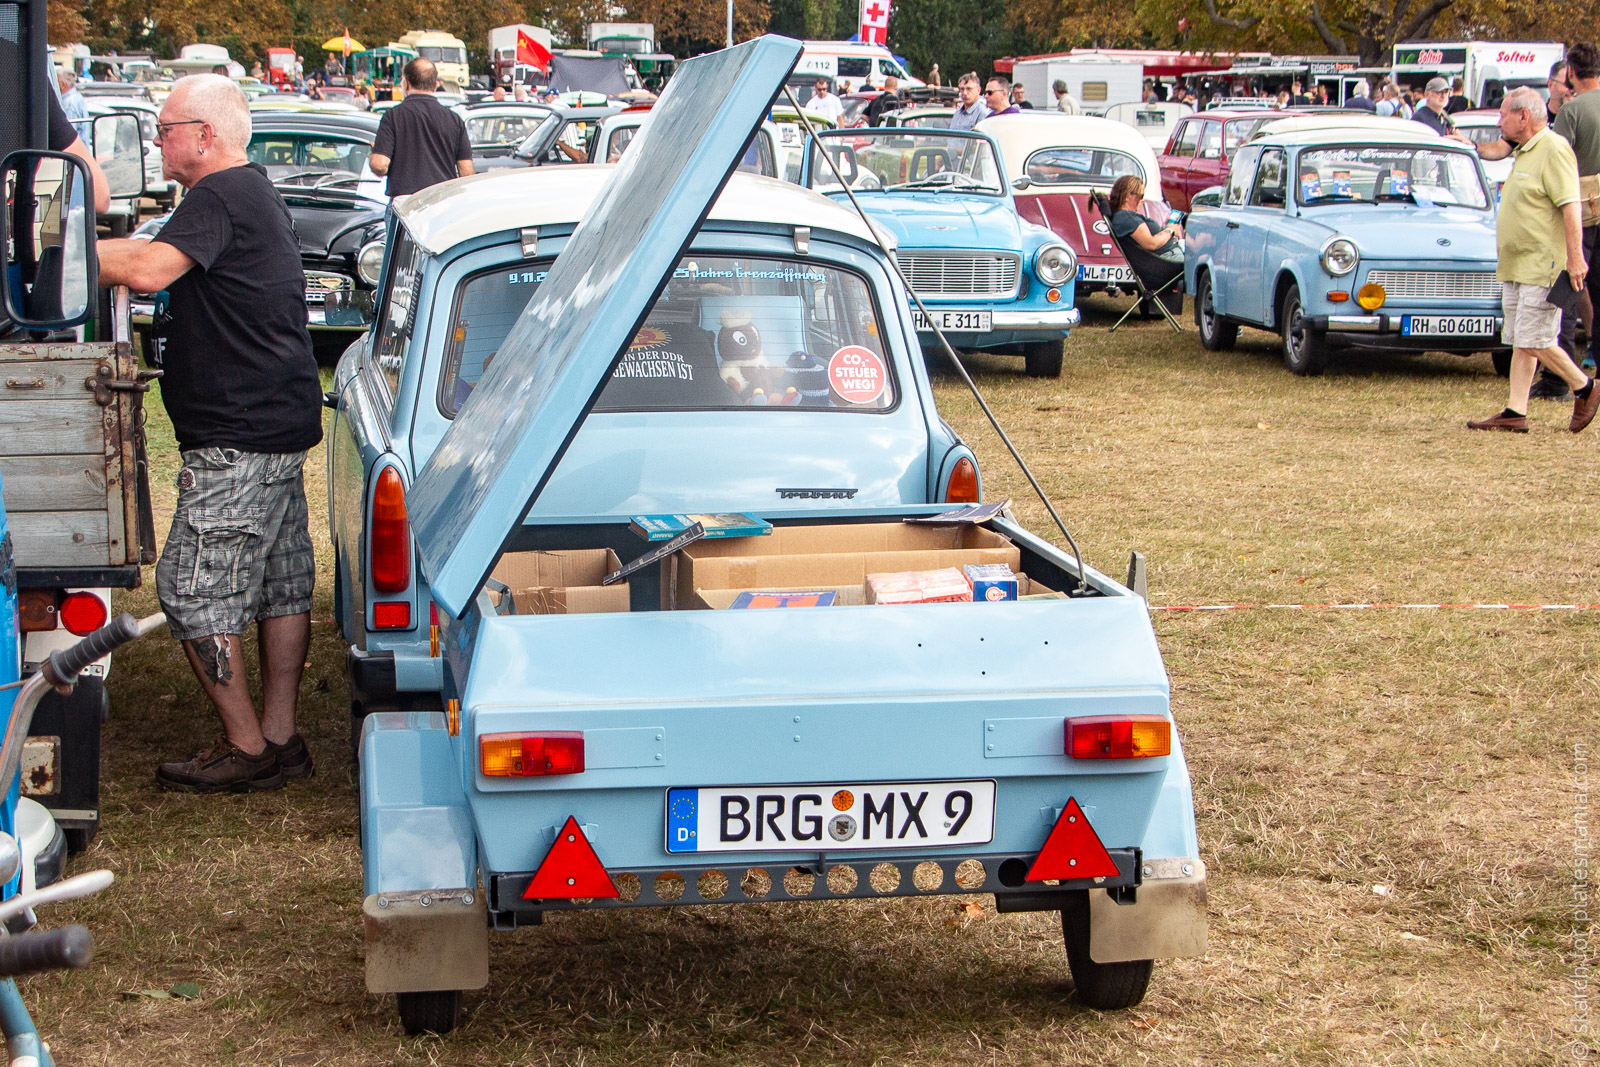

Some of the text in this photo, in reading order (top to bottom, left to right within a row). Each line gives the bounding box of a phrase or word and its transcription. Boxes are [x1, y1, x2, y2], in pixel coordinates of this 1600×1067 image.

[1417, 49, 1443, 64] Softeis
[1496, 51, 1536, 63] Softeis
[815, 61, 831, 70] 112
[508, 266, 826, 284] 9.11.2 25 Jahre Grenzöffnung
[1084, 267, 1099, 280] WL
[955, 313, 981, 329] 311
[1411, 318, 1429, 333] RH
[1438, 318, 1456, 333] GO
[623, 351, 685, 363] IN DER DDR
[613, 360, 694, 381] GEWACHSEN IST
[835, 367, 878, 378] STEUER
[841, 379, 876, 390] WEG!
[776, 488, 859, 500] Trabant
[677, 790, 974, 842] D BRG MX 9
